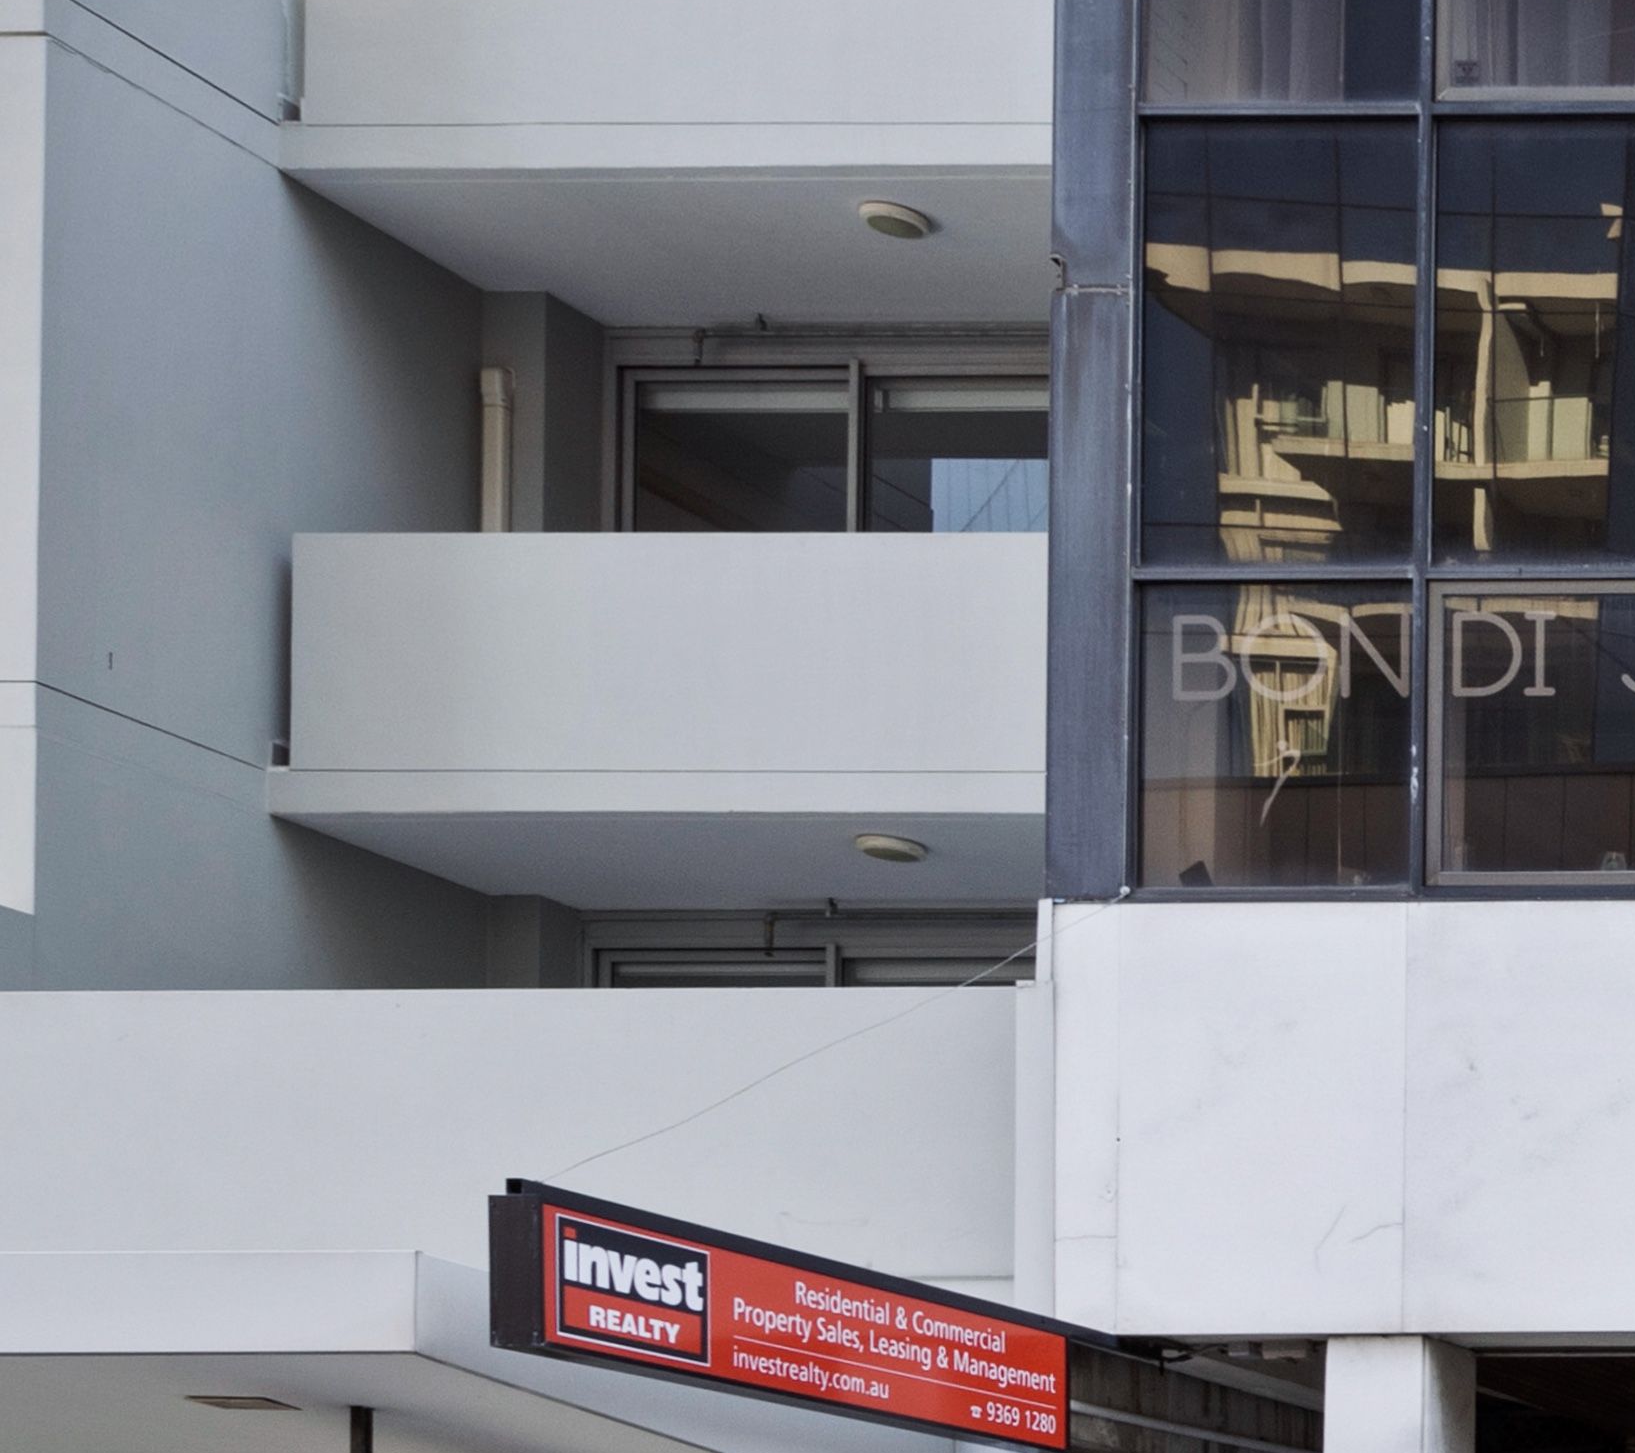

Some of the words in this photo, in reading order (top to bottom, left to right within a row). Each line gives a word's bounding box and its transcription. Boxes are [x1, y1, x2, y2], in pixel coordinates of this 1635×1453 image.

[562, 1226, 705, 1312] invest
[589, 1305, 681, 1345] REALTY
[732, 1296, 813, 1344] Property
[816, 1317, 865, 1354] Sales,
[869, 1328, 933, 1371] Leasing
[936, 1346, 950, 1368] &
[953, 1351, 1057, 1395] Management
[794, 1280, 891, 1325] Residential
[896, 1306, 909, 1331] &
[911, 1311, 1007, 1354] Commercial
[732, 1345, 890, 1400] investrealty.com.au
[985, 1401, 1021, 1428] 9369
[1024, 1410, 1057, 1436] 1280
